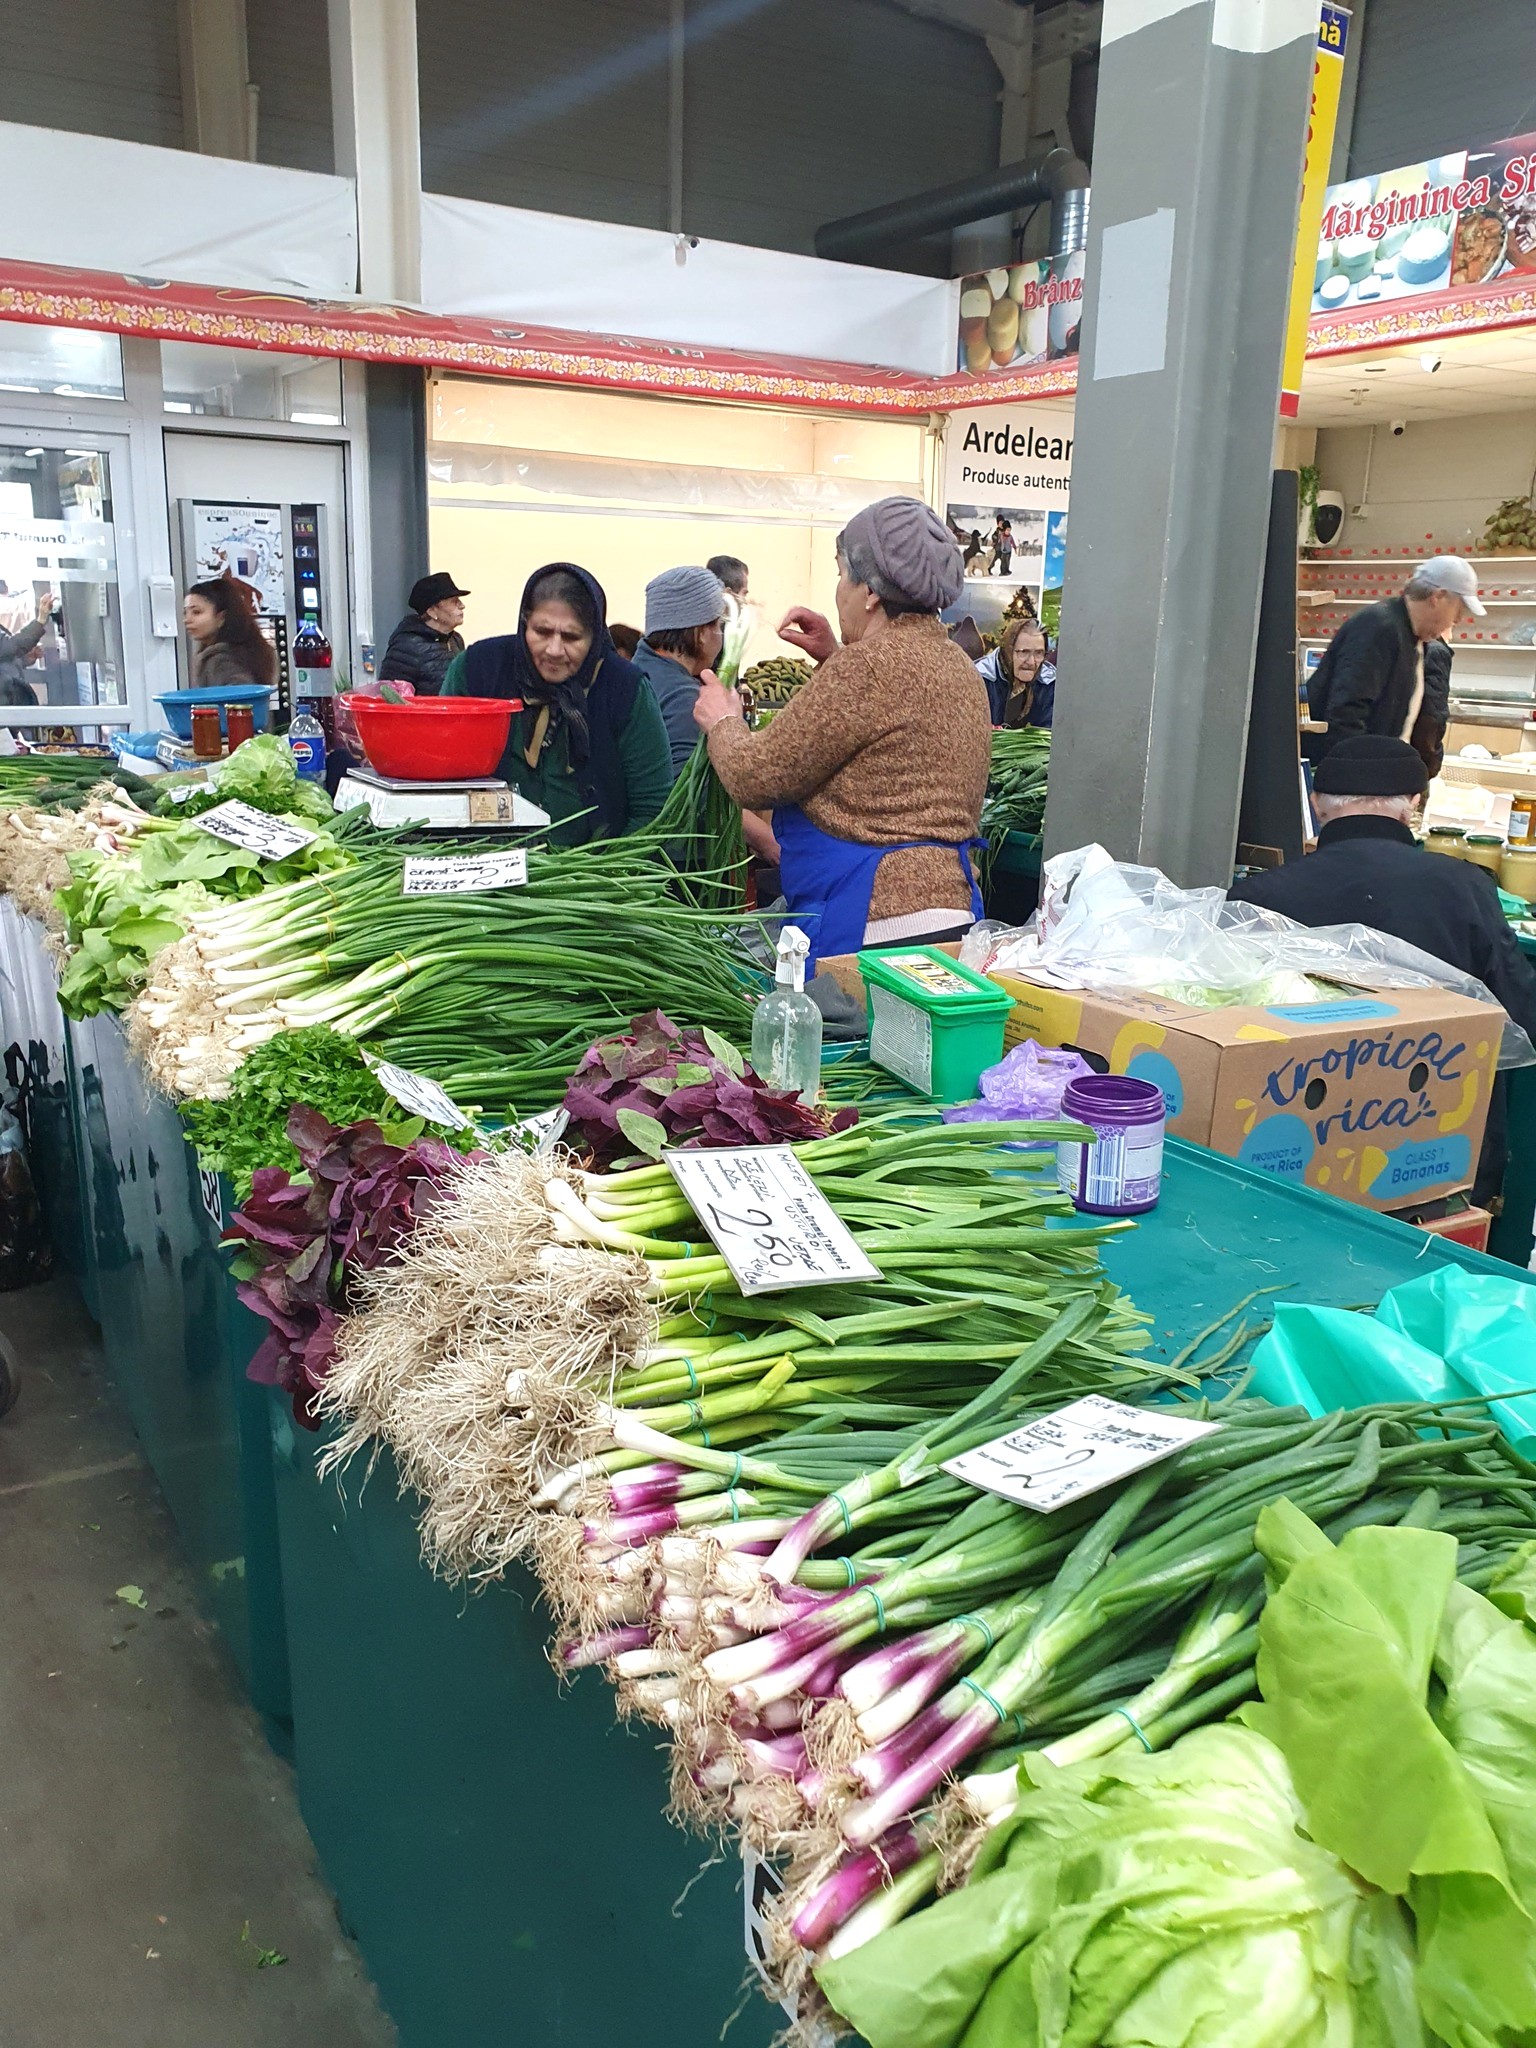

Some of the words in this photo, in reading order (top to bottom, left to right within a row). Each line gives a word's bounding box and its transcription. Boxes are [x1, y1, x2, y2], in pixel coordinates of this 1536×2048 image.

[1319, 19, 1341, 46] nă
[1500, 153, 1536, 200] Si
[1022, 274, 1083, 310] Brânz
[963, 466, 1019, 486] Produse
[293, 749, 312, 757] PEPSI
[472, 867, 499, 886] 2
[1315, 1098, 1420, 1146] rica
[1251, 1149, 1290, 1162] PRODUCT
[1291, 1146, 1302, 1157] OF
[1405, 1148, 1437, 1166] CLASS
[1277, 1159, 1303, 1173] Rica
[1391, 1162, 1450, 1184] Bananas
